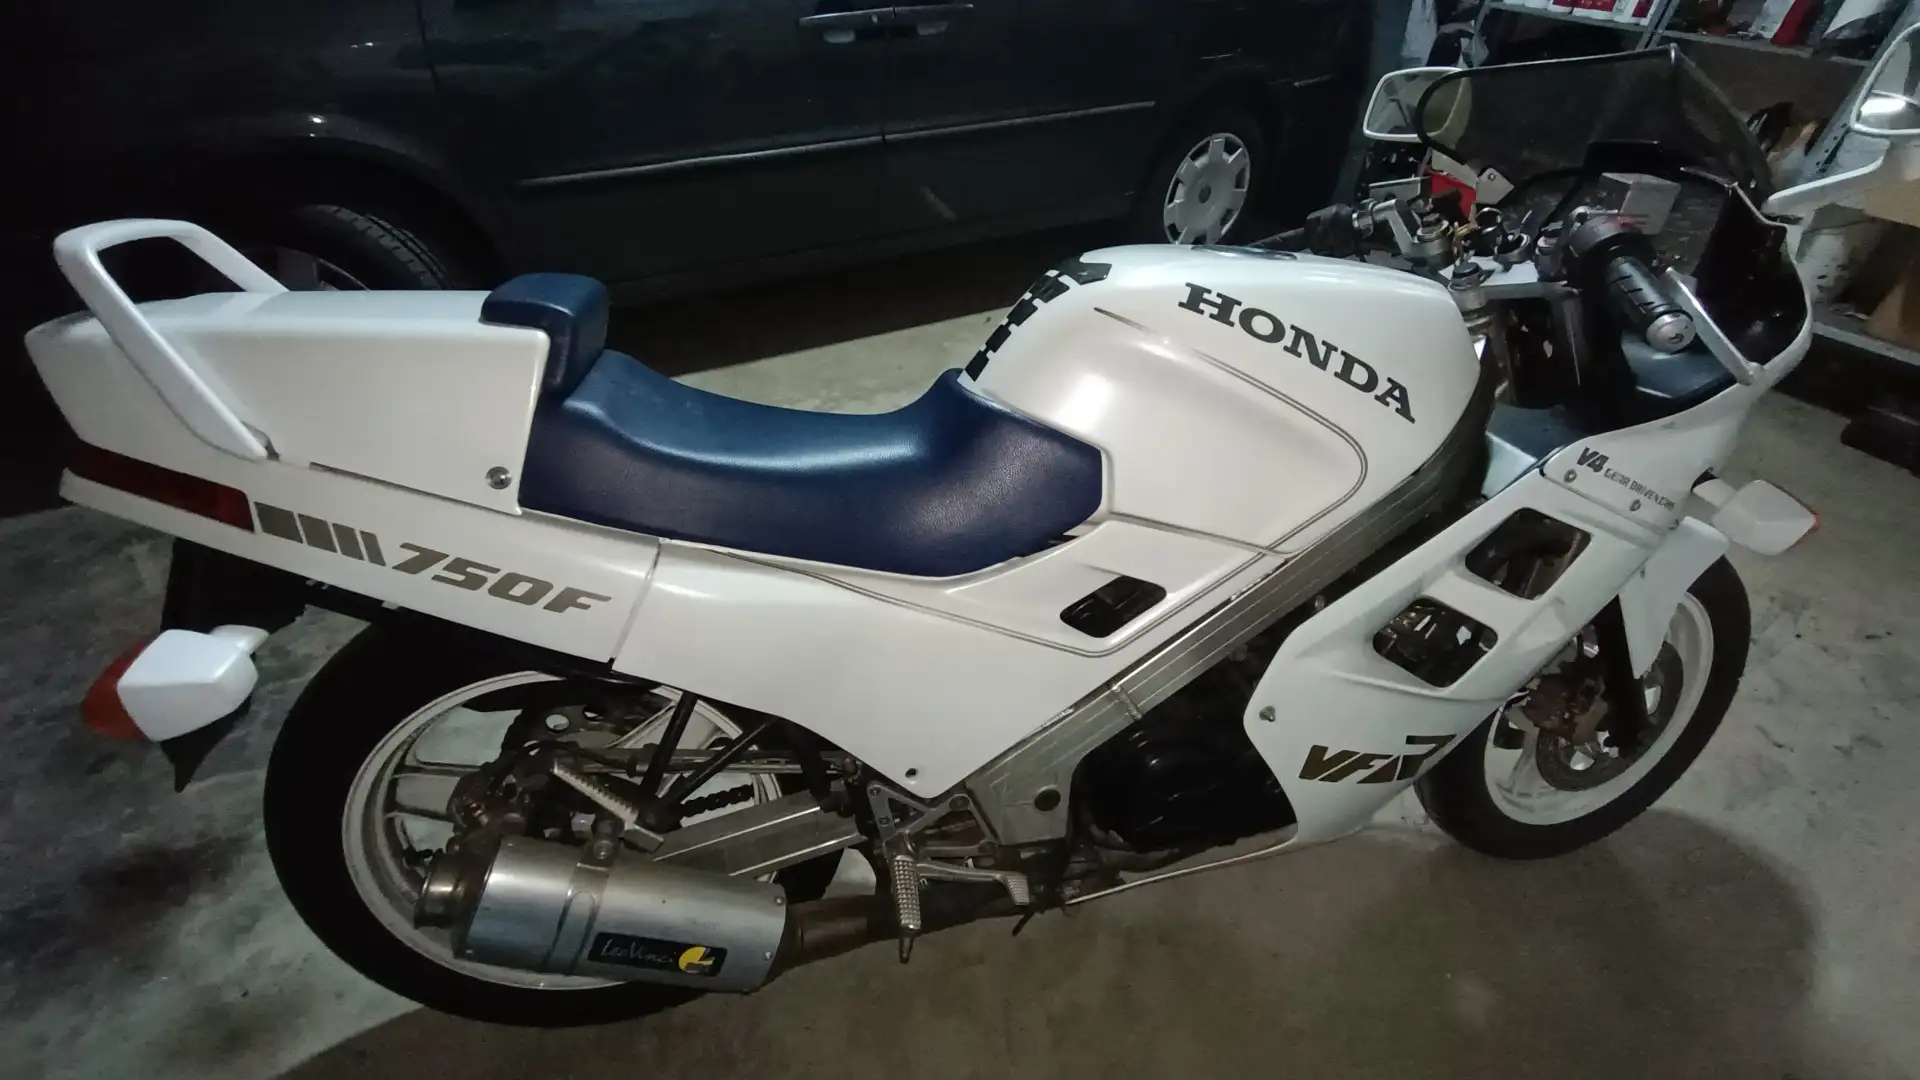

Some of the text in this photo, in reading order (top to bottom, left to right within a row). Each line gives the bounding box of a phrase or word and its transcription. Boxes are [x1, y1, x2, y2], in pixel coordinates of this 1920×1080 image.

[1178, 282, 1415, 424] HONDA
[1576, 446, 1609, 472] V4
[392, 542, 612, 613] 750F
